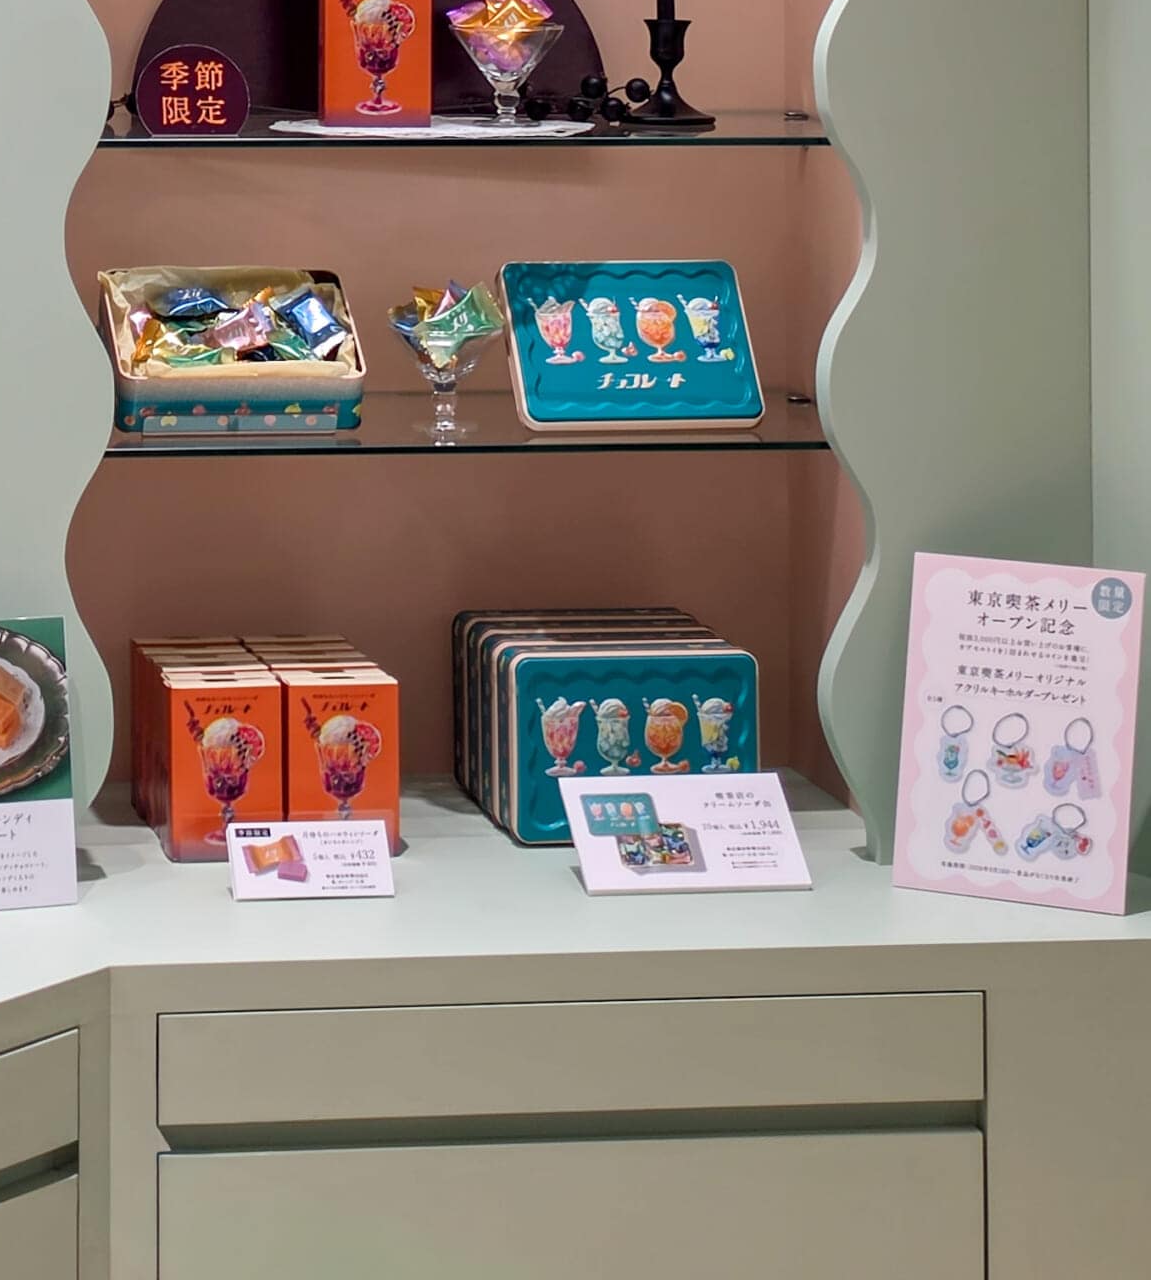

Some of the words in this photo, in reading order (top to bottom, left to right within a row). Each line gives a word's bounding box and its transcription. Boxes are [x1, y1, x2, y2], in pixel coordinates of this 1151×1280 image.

[159, 61, 225, 92] 季節
[161, 95, 227, 126] 限定
[968, 590, 1088, 614] 東京喫茶メリー
[977, 611, 1075, 636] オープン記念
[957, 664, 1087, 687] 東京喫茶メリーオリジナル
[954, 682, 1087, 706] アクリルキーホルダープレゼント
